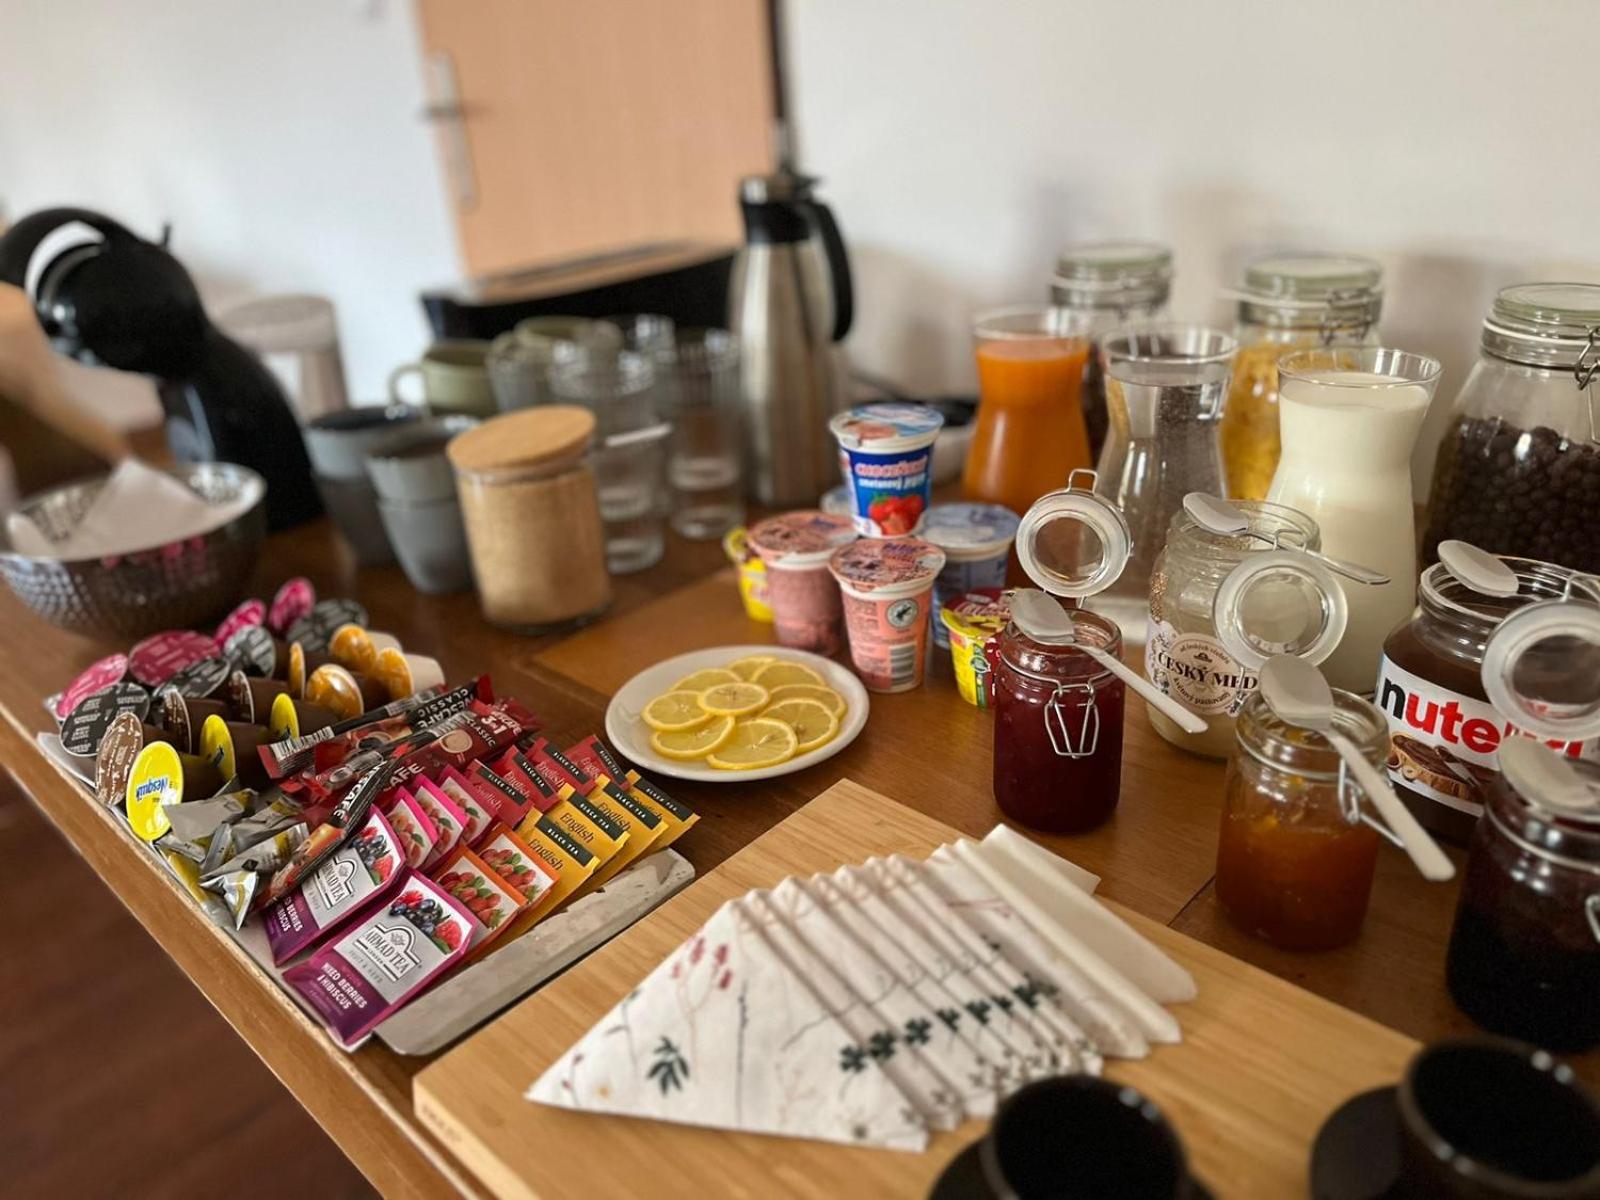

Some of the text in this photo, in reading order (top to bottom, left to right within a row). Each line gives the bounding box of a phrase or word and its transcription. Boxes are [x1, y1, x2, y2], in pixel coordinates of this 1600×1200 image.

[418, 688, 469, 717] CLASSIC
[464, 716, 497, 748] CLASSIC
[1380, 677, 1585, 760] nute
[553, 752, 580, 776] BLACK TEA
[600, 750, 612, 766] BLACK
[488, 774, 516, 796] BLACK TEA
[522, 761, 545, 788] BLACK TEA
[537, 761, 567, 788] English
[615, 792, 634, 809] BLACK
[634, 807, 646, 819] TEA
[646, 788, 664, 802] BLACK
[665, 801, 678, 812] TEA
[560, 812, 595, 844] English
[579, 802, 610, 829] BLACK TEA
[599, 801, 632, 831] English
[529, 838, 564, 871] English
[547, 828, 567, 845] BLACK
[567, 843, 579, 855] TEA
[286, 903, 304, 932] BERRIES
[365, 930, 412, 975] AHMAD TEA
[321, 961, 342, 981] MIXED
[340, 978, 368, 1009] BERRIES
[321, 978, 352, 1010] HIBISCUS
